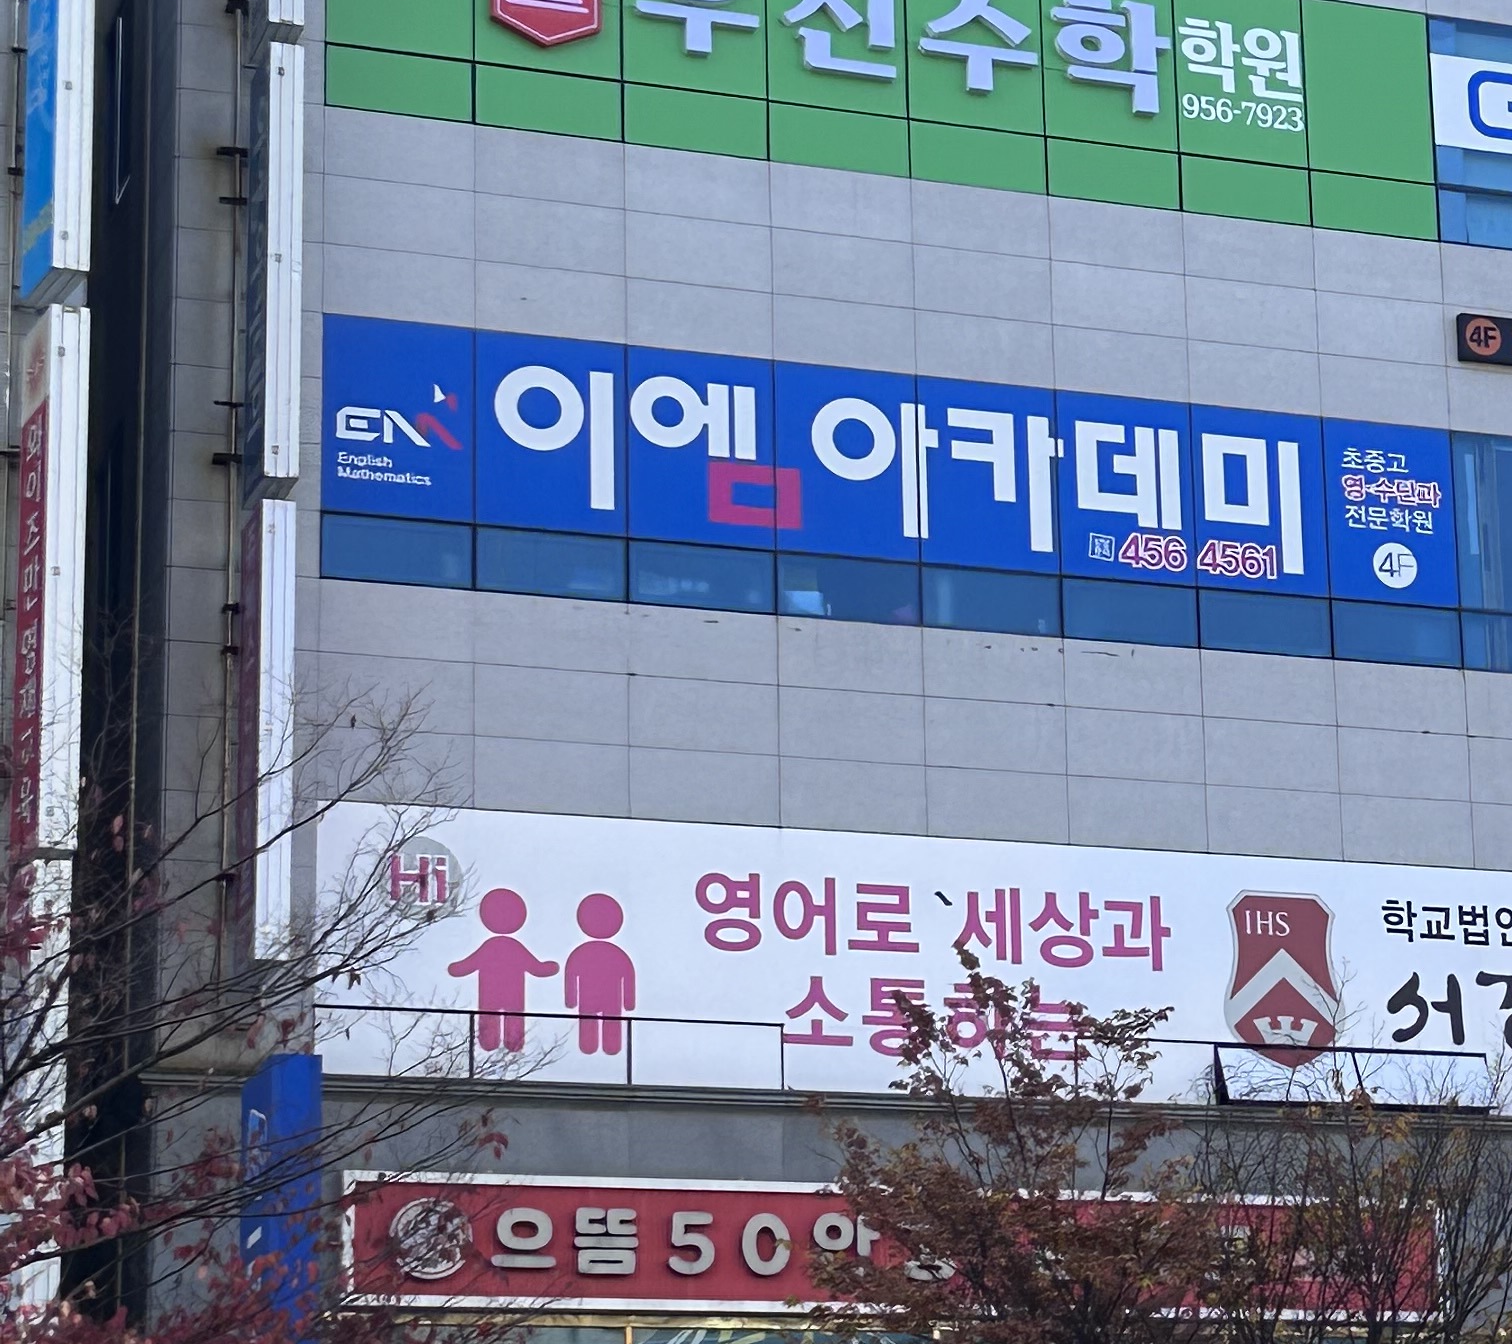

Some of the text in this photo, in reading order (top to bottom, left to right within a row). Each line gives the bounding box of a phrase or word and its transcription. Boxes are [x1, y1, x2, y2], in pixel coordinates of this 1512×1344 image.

[1178, 17, 1304, 102] 학원
[1181, 93, 1305, 132] 956-7923
[1469, 325, 1498, 349] 4F
[337, 452, 394, 470] English
[494, 365, 1305, 577] 이엠 아카데미
[1341, 447, 1410, 474] 초중고
[337, 466, 433, 487] Mathematics
[1344, 504, 1434, 535] 전문학원
[1118, 532, 1188, 572] 456
[1197, 539, 1278, 580] 4561
[1378, 552, 1415, 578] 4F
[390, 855, 448, 907] Hi
[695, 872, 1172, 973] 영어로 세상과
[1244, 908, 1291, 939] IHS
